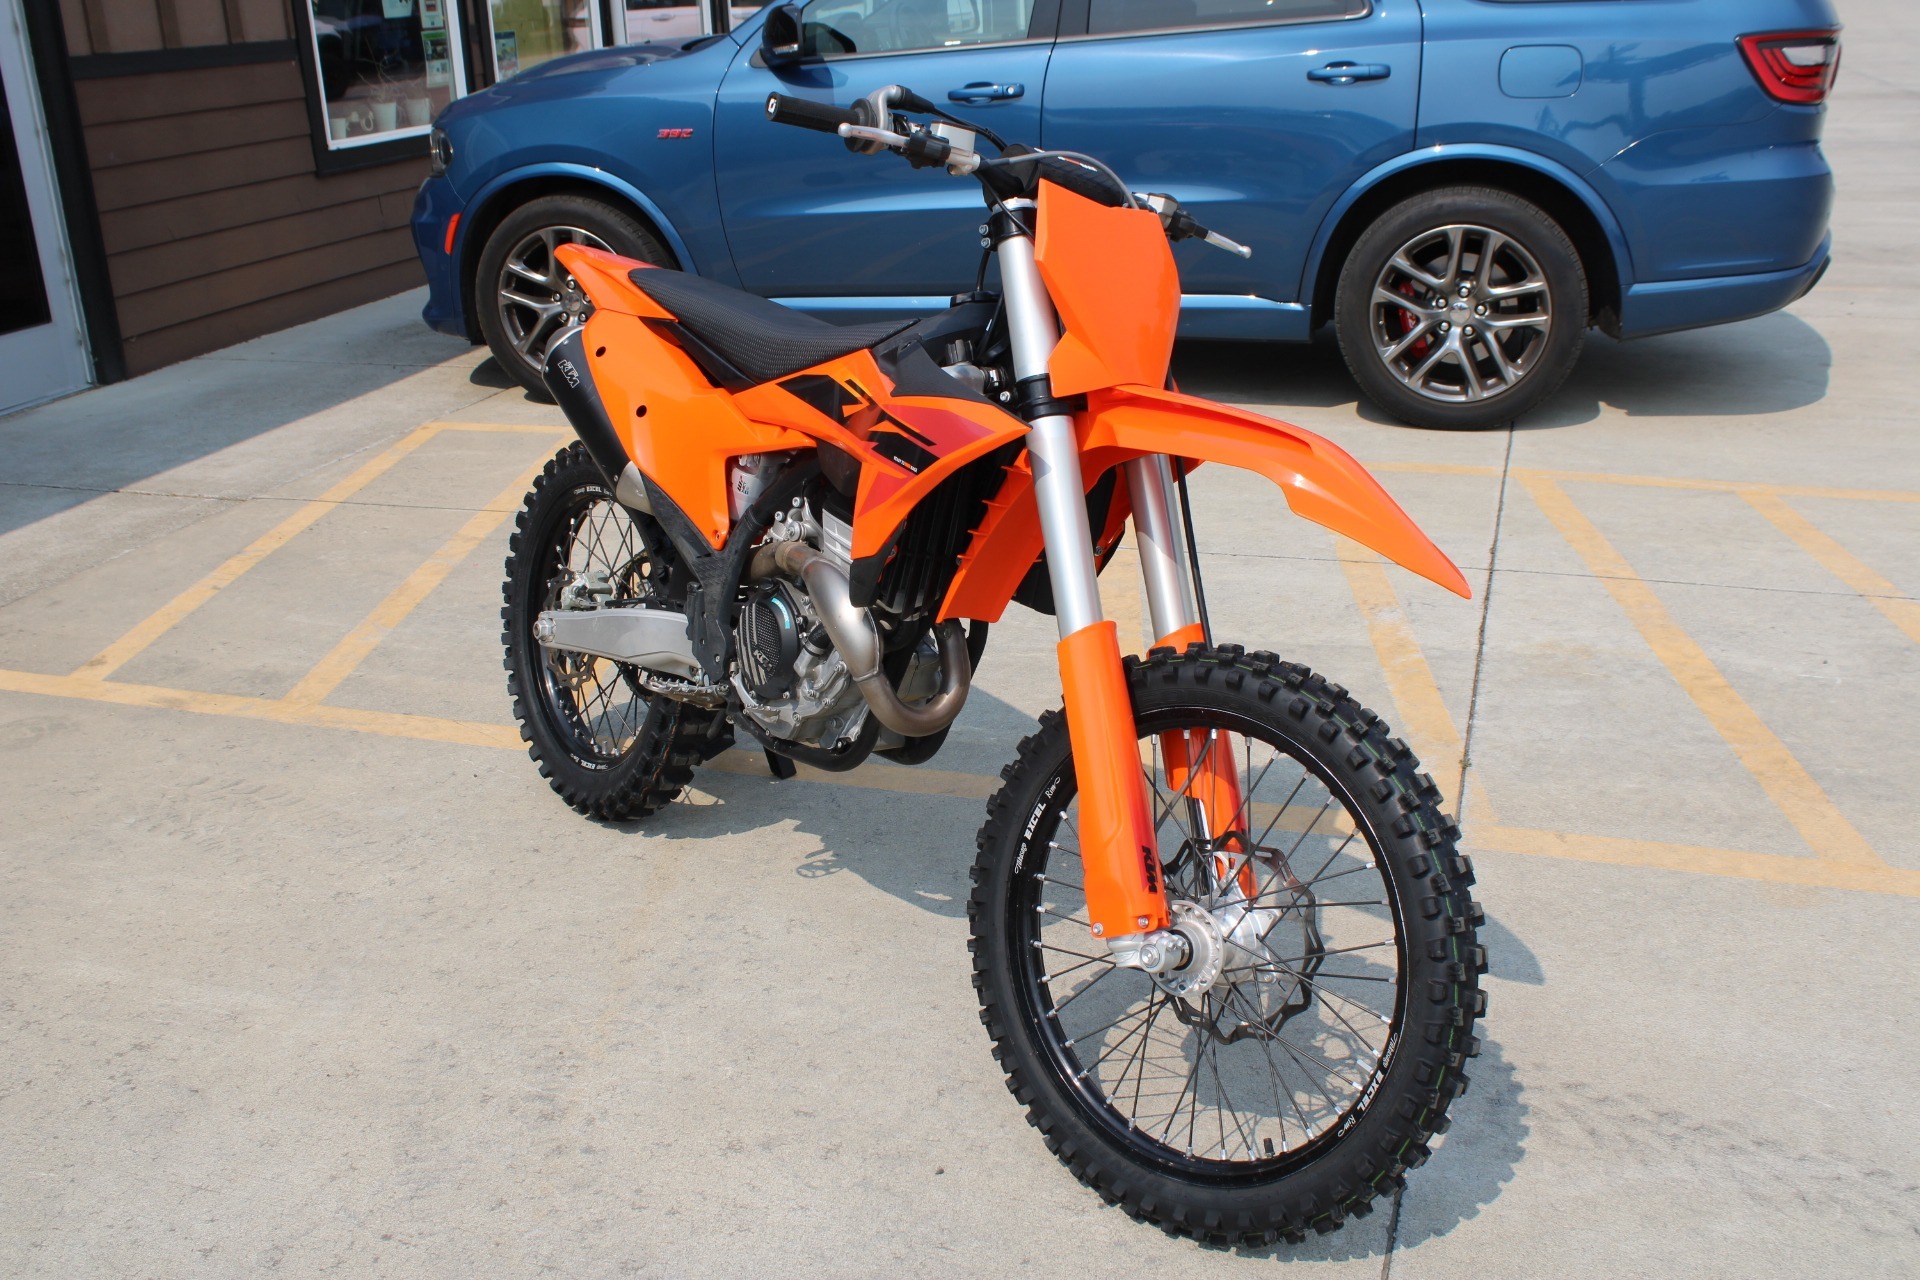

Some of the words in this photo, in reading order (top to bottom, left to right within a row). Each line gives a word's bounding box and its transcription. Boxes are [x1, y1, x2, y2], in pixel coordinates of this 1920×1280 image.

[657, 128, 694, 139] 392
[557, 359, 580, 389] KTM
[1023, 802, 1047, 841] EXCEL
[1141, 845, 1158, 894] KTM
[1356, 1069, 1385, 1112] EXCEL
